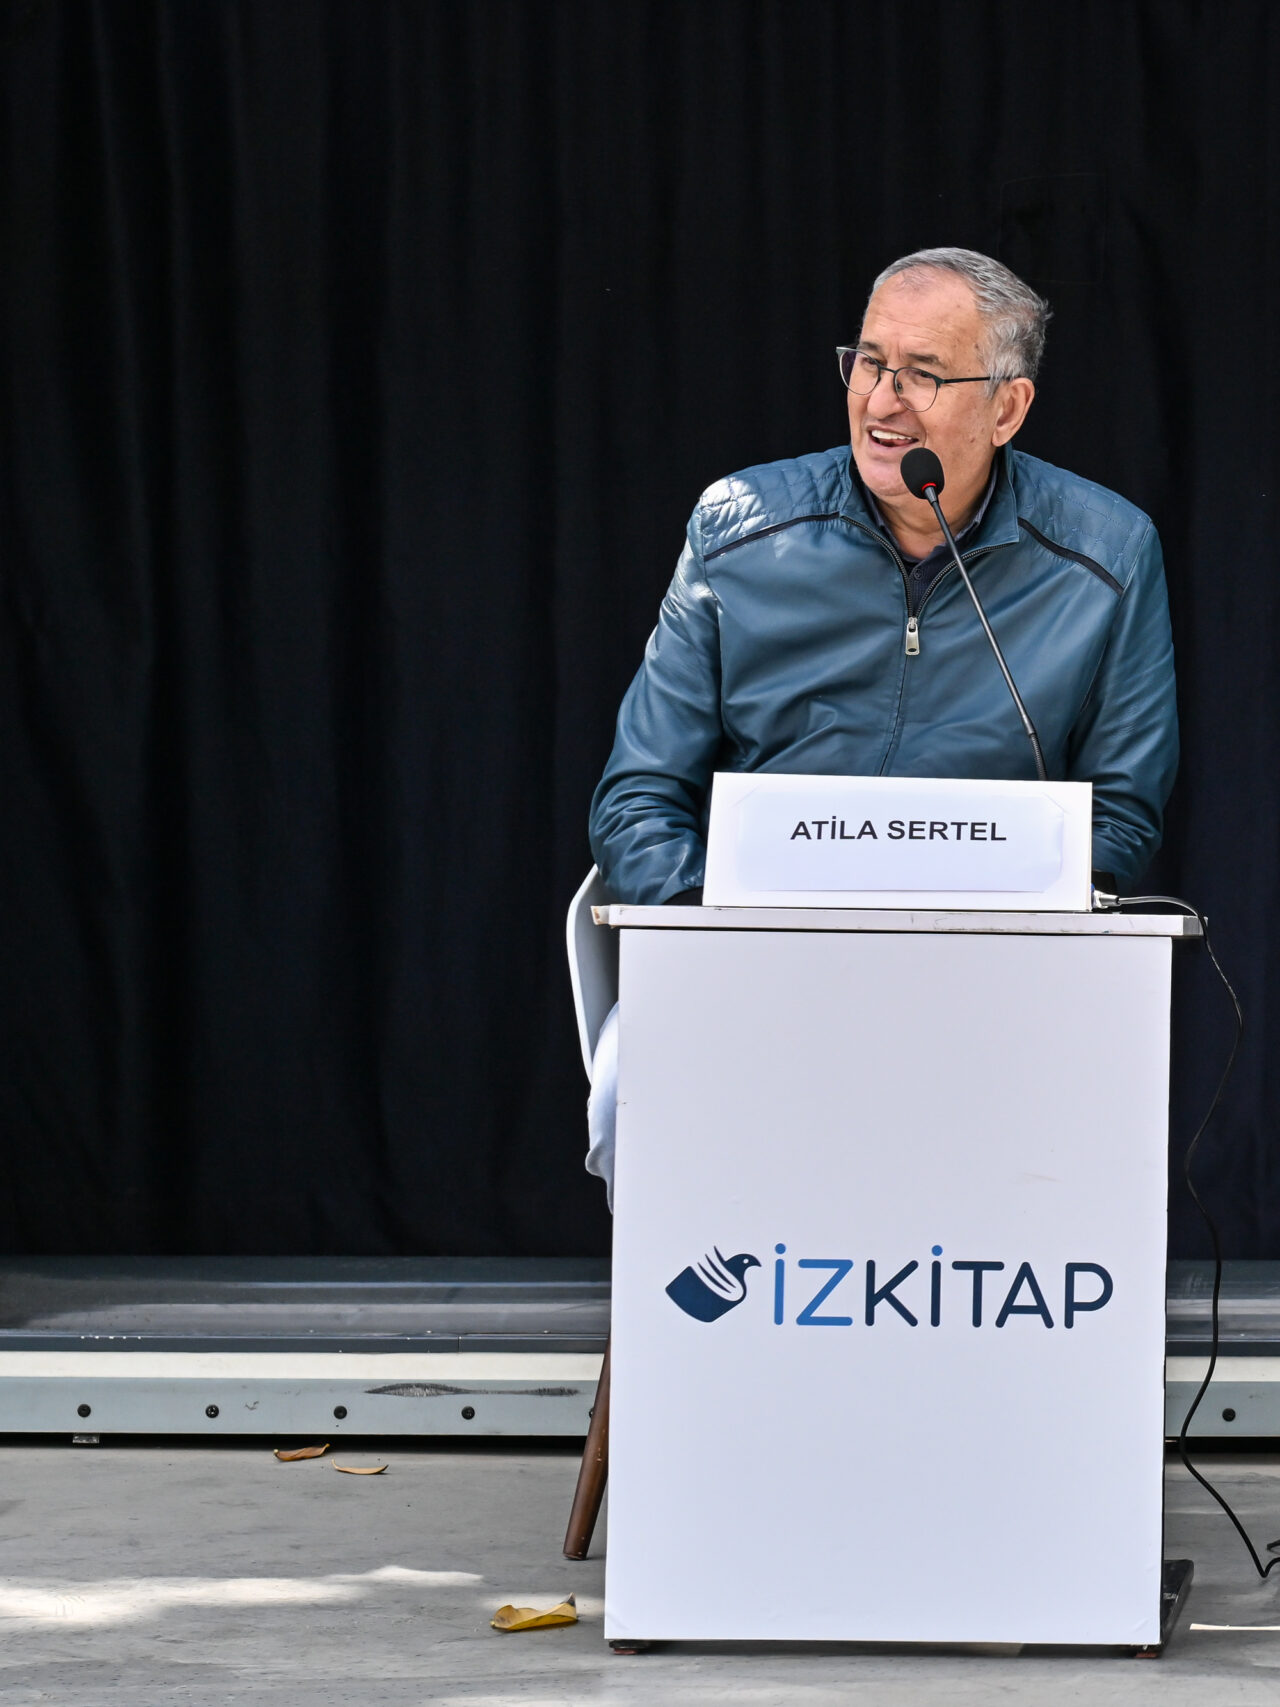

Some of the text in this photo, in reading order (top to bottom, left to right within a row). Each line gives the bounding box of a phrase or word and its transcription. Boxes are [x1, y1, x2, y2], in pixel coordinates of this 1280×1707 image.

[790, 815, 1007, 841] ATİLA SERTEL
[773, 1242, 1114, 1330] İZKİTAP
